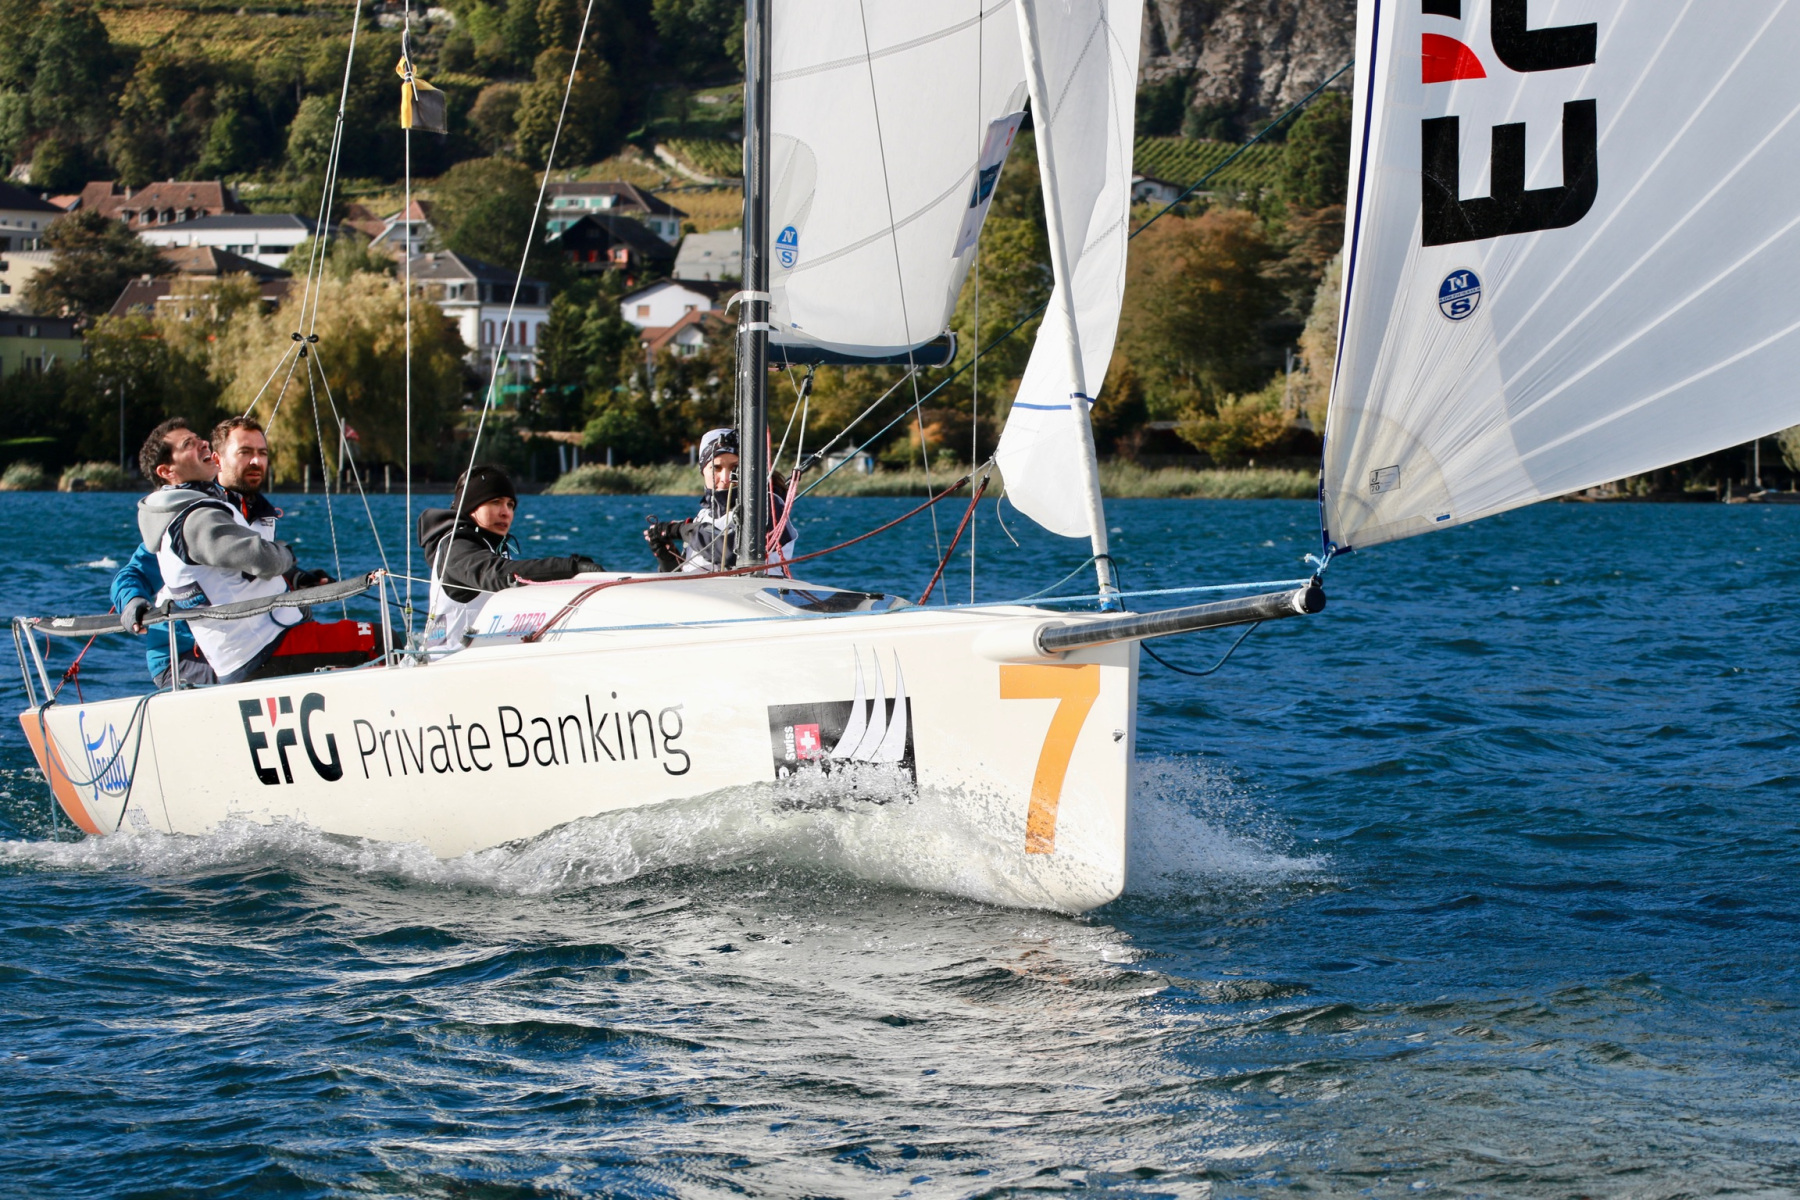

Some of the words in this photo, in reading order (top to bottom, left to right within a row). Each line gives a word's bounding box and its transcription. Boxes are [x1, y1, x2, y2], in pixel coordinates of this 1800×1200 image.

[238, 692, 343, 785] EFG
[353, 709, 493, 779] Private
[498, 691, 691, 776] Banking
[1000, 664, 1100, 854] 7
